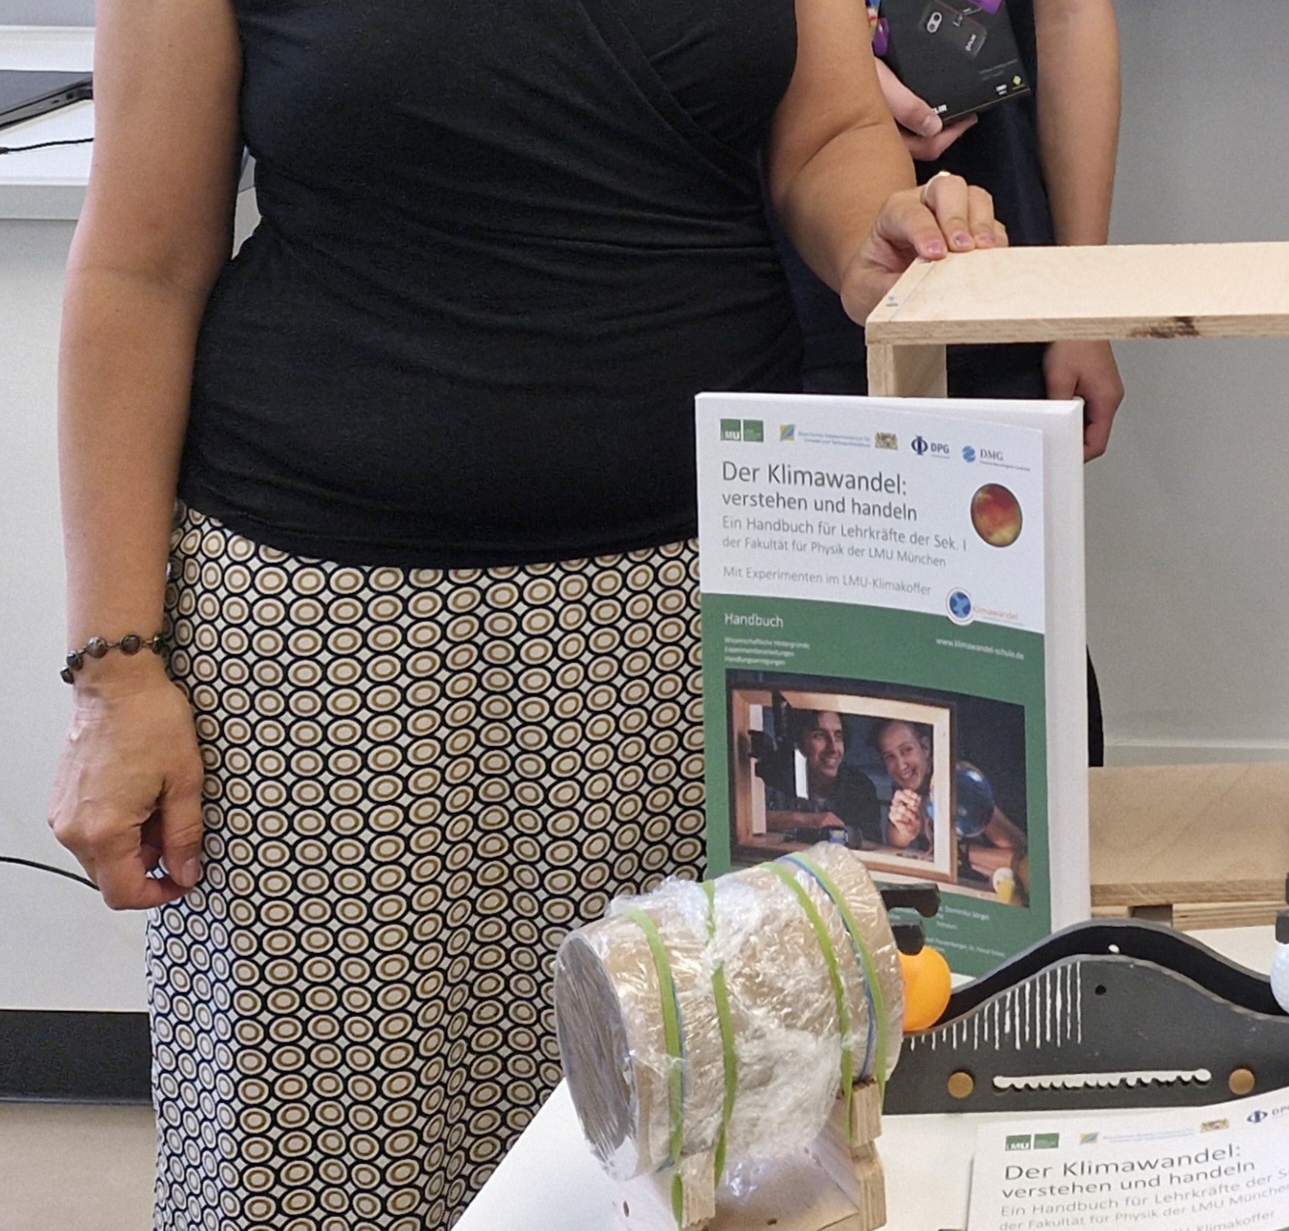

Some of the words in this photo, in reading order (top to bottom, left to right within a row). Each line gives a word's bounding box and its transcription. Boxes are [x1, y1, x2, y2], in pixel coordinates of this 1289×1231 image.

[930, 442, 950, 454] DPG
[979, 449, 1004, 462] DMG
[722, 460, 760, 483] Der
[767, 463, 907, 496] Klimawandel:
[722, 491, 808, 511] verstehen
[814, 496, 846, 514] und
[851, 497, 918, 522] handeln
[722, 515, 742, 530] Ein
[746, 517, 814, 535] Handbuch
[818, 520, 835, 536] für
[840, 524, 905, 544] Lehrkräfte
[909, 532, 931, 547] der
[933, 534, 960, 551] Sek.
[722, 536, 741, 549] der
[744, 537, 789, 552] Fakultät
[792, 539, 808, 553] für
[811, 541, 845, 557] Physik
[847, 545, 866, 558] der
[868, 546, 894, 561] LMU
[896, 550, 947, 568] München
[722, 566, 742, 579] Mit
[746, 567, 823, 585] Experimenten
[826, 573, 840, 585] im
[842, 574, 932, 596] LMU-Klimakoffer
[724, 612, 784, 628] Handbuch
[1004, 1164, 1053, 1181] Der
[1062, 1143, 1241, 1177] Klimawandel:
[1000, 1205, 1026, 1217] Ein
[1031, 1198, 1119, 1215] Handbuch
[1124, 1194, 1149, 1207] für
[1154, 1178, 1240, 1204] Lehrkräfte
[1245, 1173, 1272, 1187] der
[1001, 1181, 1112, 1199] verstehen
[1120, 1174, 1161, 1191] und
[1169, 1161, 1256, 1186] handeln
[998, 1221, 1023, 1231] der
[1028, 1217, 1085, 1231] Fakultät
[1089, 1214, 1110, 1225] für
[1115, 1209, 1159, 1224] Physik
[1162, 1206, 1186, 1218] der
[1191, 1199, 1225, 1213] LMU
